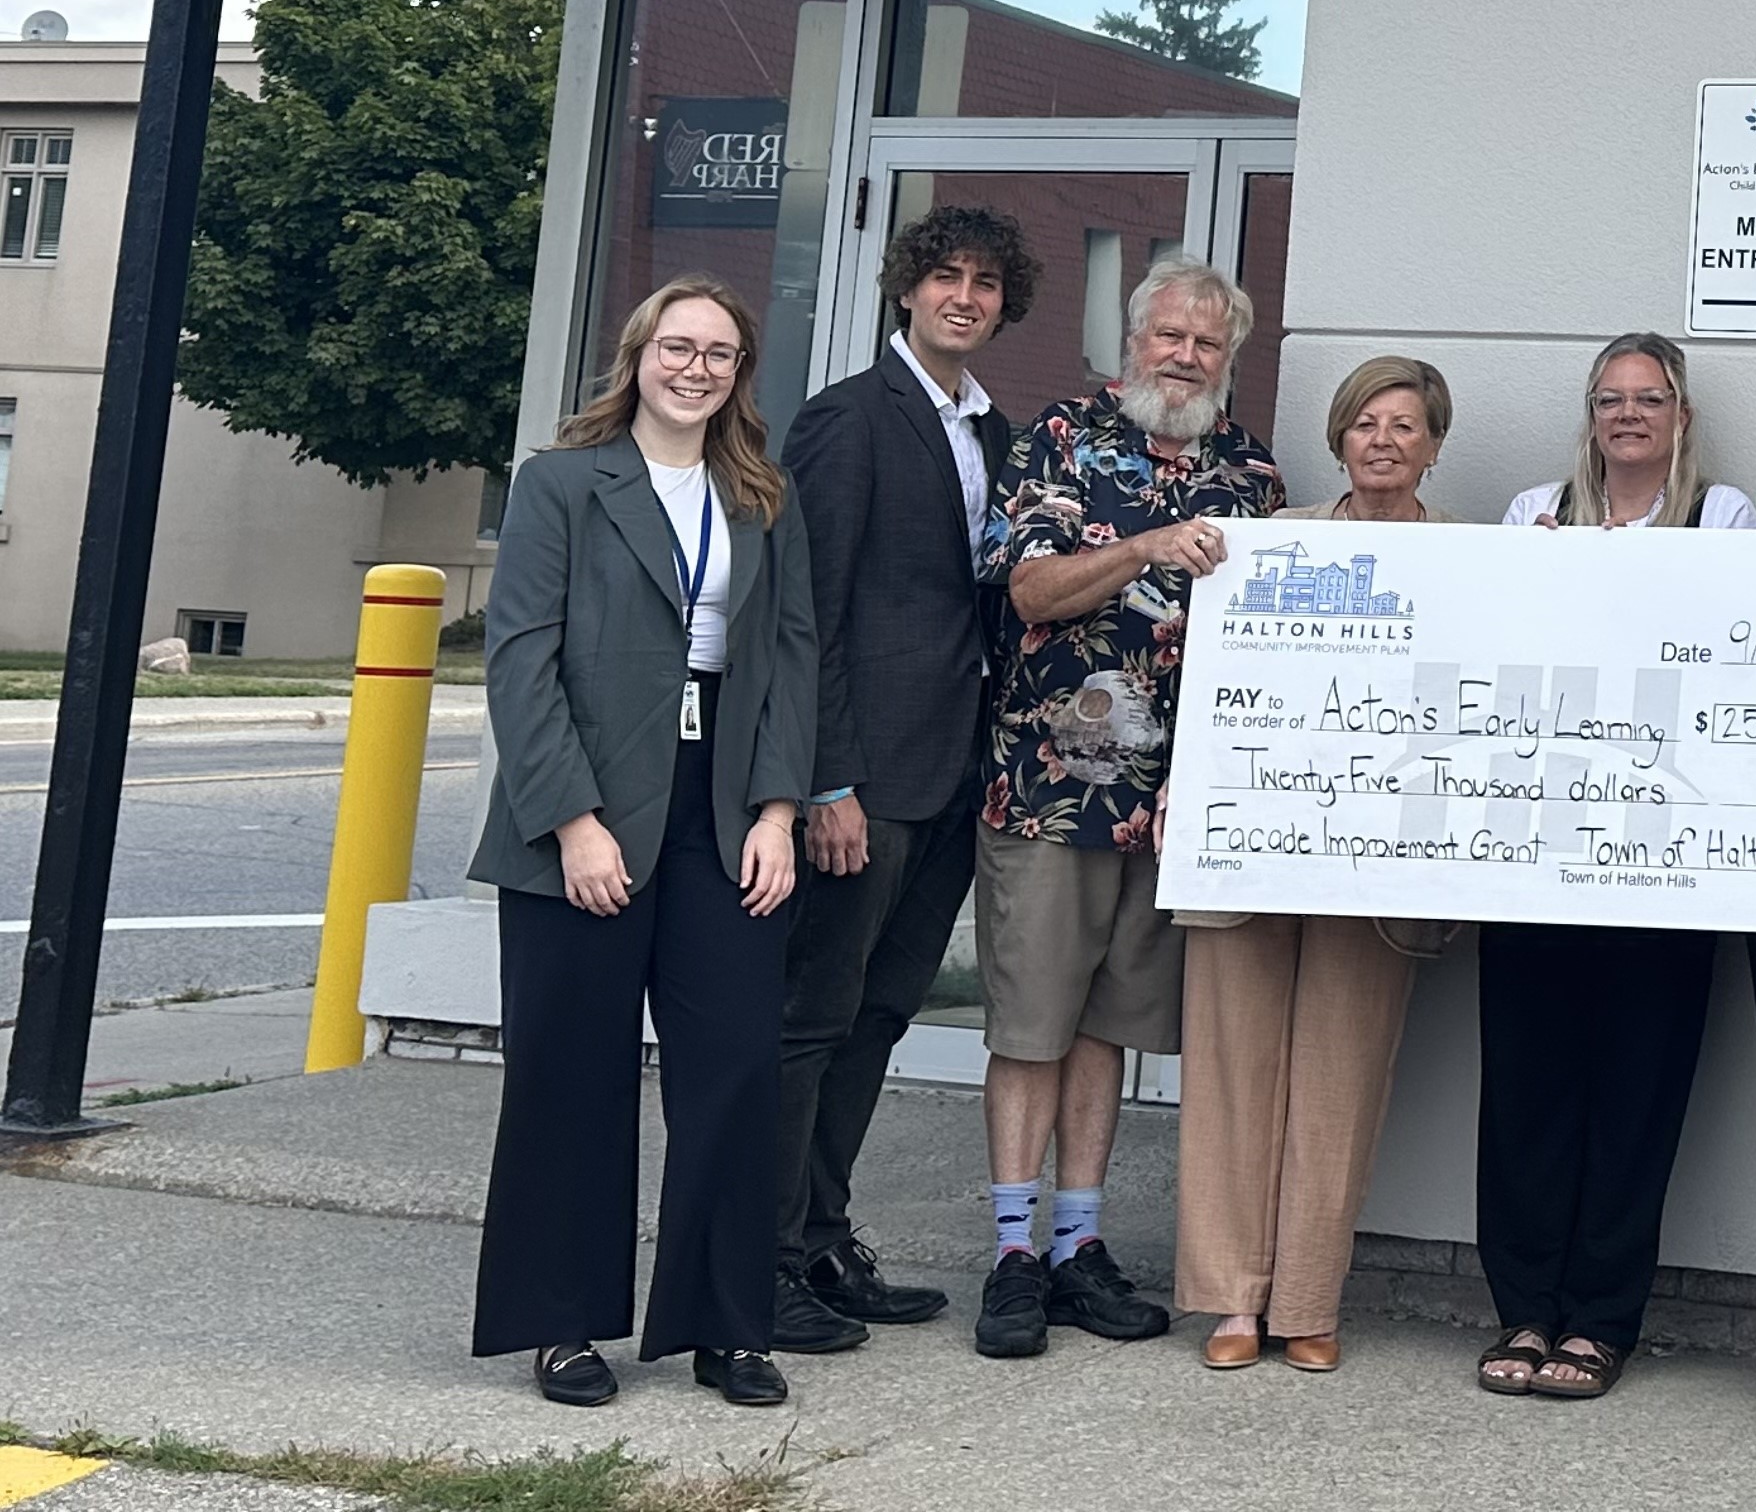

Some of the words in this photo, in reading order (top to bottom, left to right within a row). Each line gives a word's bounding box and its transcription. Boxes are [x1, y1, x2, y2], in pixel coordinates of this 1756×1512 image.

[1703, 163, 1750, 175] Acton's
[1729, 181, 1755, 191] Child
[1222, 620, 1325, 637] HALTON
[1341, 624, 1413, 639] HILLS
[1221, 640, 1292, 652] COMMUNITY
[1295, 643, 1377, 654] IMPROVEMENT
[1380, 645, 1410, 655] PLAN
[1660, 642, 1712, 663] Date
[1215, 688, 1262, 708] PAY
[1268, 695, 1283, 709] to
[1213, 713, 1238, 728] the
[1242, 713, 1285, 729] order
[1289, 714, 1306, 729] of
[1319, 676, 1438, 734] Acton's
[1458, 680, 1540, 758] Early
[1555, 692, 1665, 768] Learning
[1695, 710, 1708, 735] $
[1232, 746, 1401, 807] Twenty-Five
[1421, 755, 1544, 801] Thousand
[1569, 769, 1665, 805] dollars
[1206, 802, 1312, 853] Facade
[1469, 828, 1547, 865] Grant
[1576, 827, 1649, 867] Town
[1662, 827, 1697, 868] of
[1197, 855, 1243, 871] Memo
[1559, 870, 1595, 885] Town
[1598, 871, 1613, 886] of
[1617, 872, 1663, 888] Halton
[1666, 874, 1697, 889] Hills
